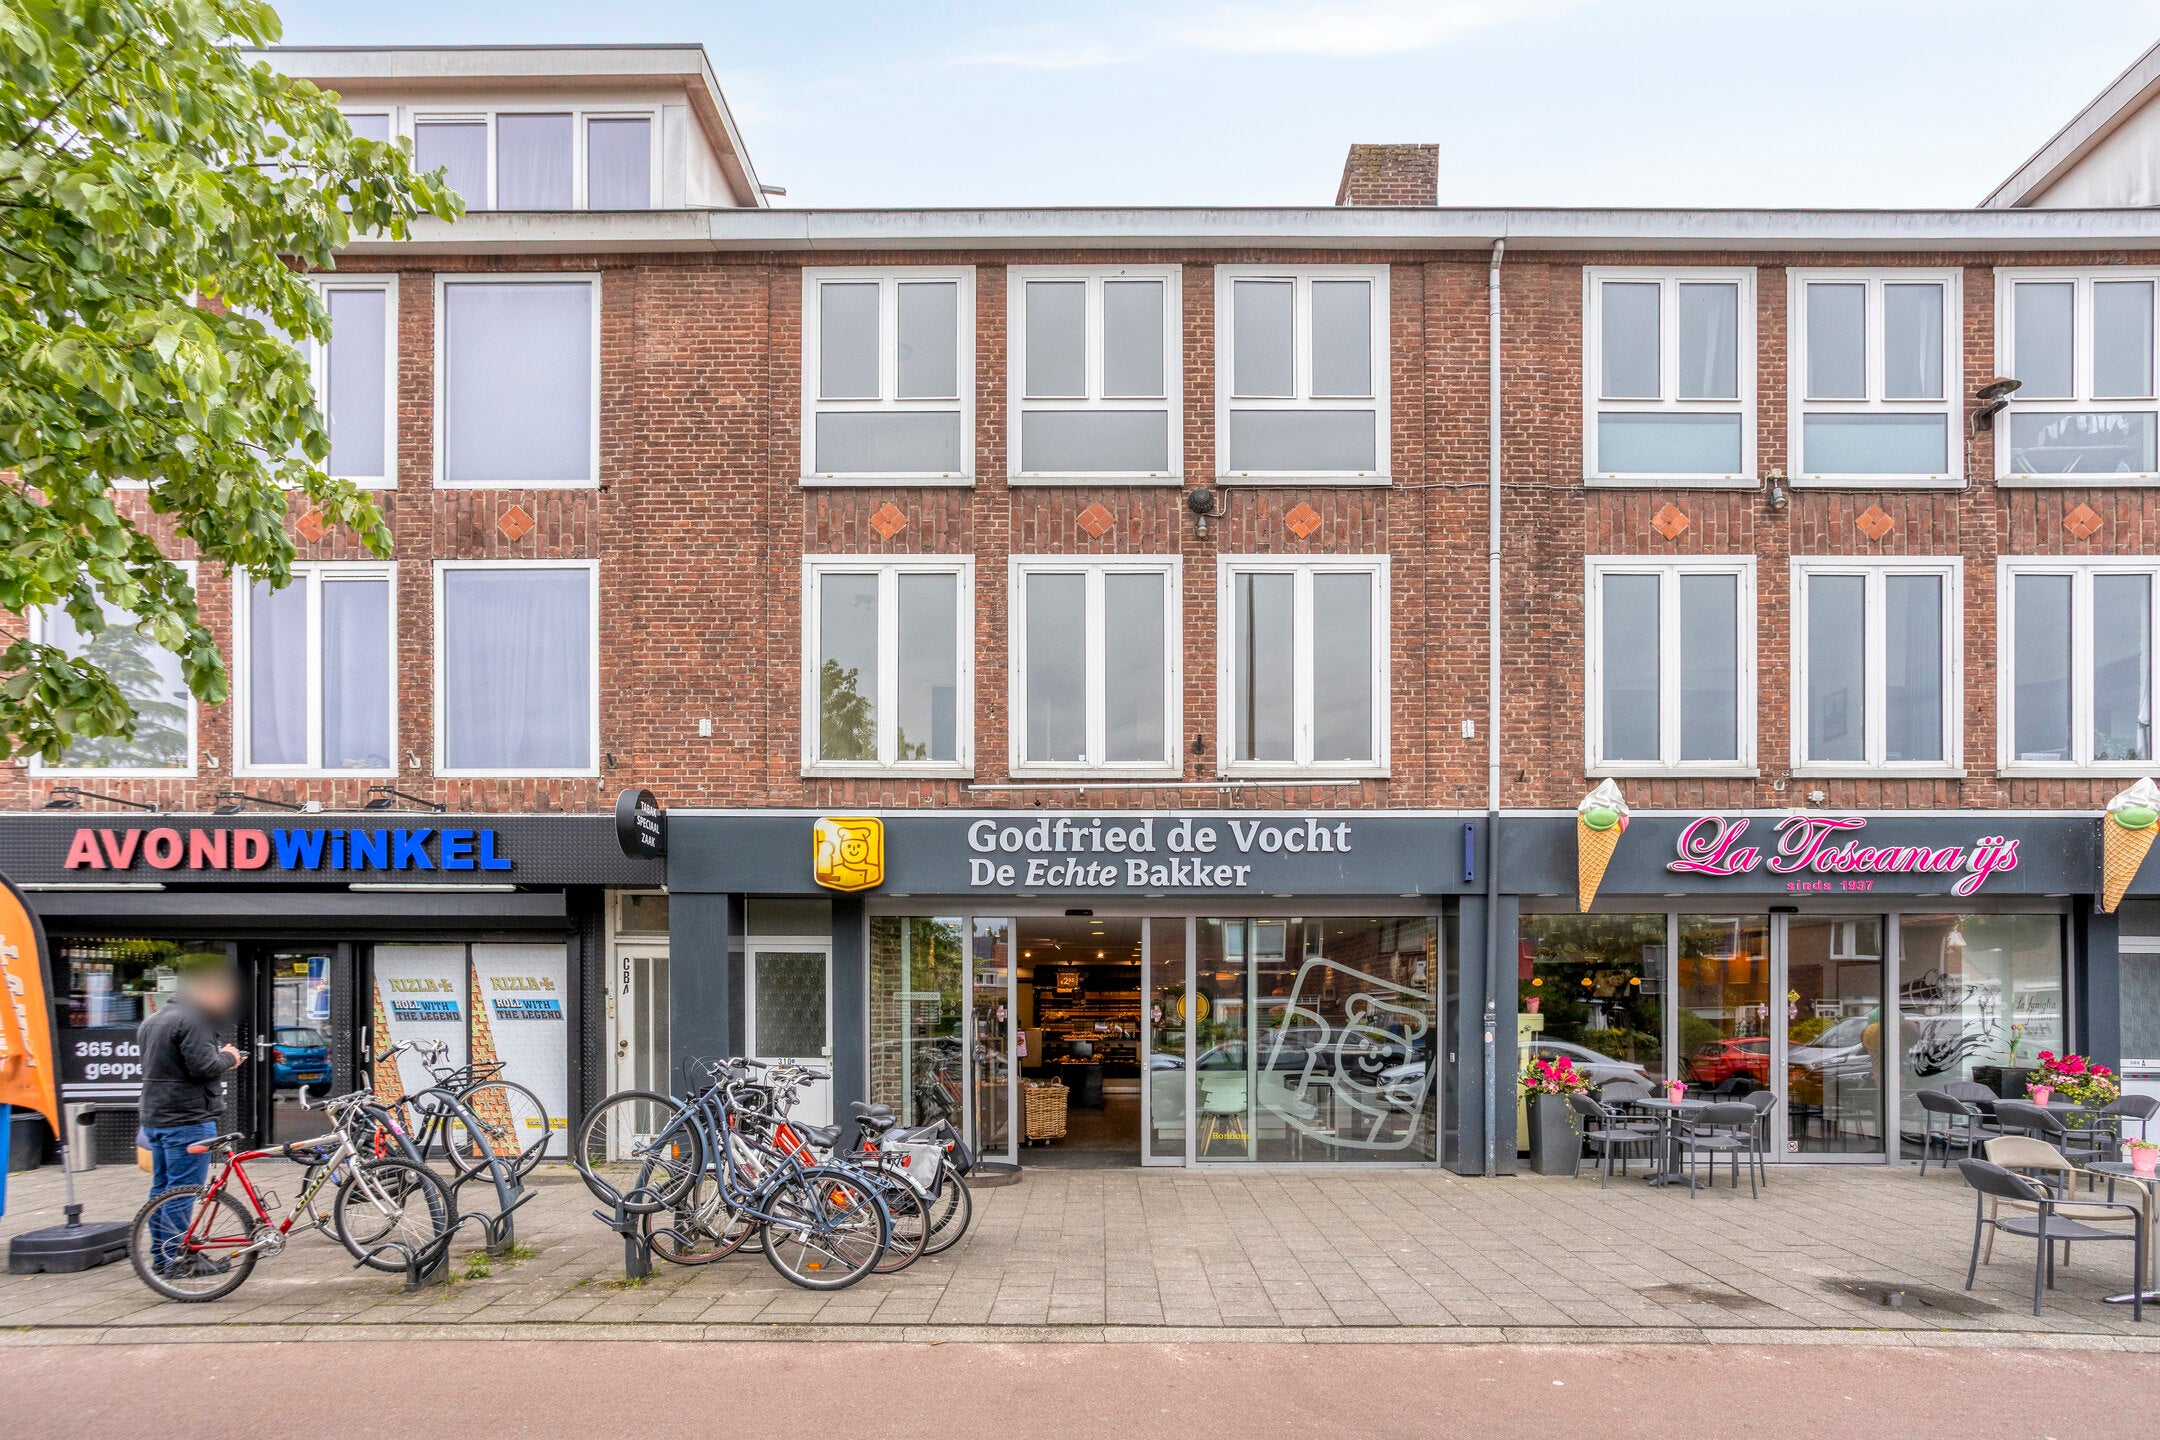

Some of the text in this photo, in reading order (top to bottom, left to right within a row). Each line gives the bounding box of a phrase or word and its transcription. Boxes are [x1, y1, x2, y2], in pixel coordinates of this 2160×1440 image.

[640, 801, 657, 817] TABAK
[636, 815, 660, 835] SPECIAAL
[641, 832, 656, 848] ZAAK
[967, 818, 1353, 853] Godfried de Vocht
[1667, 815, 1762, 877] La
[968, 857, 1252, 888] De Echte Bakker
[1786, 880, 1873, 892] sinds 1937
[394, 1000, 449, 1011] ROLL WITH
[495, 998, 551, 1010] ROLL WITH
[395, 1011, 461, 1021] THE LEGEND
[496, 1010, 562, 1020] THE LEGEND
[75, 1042, 112, 1057] 365
[85, 1063, 143, 1080] geope
[295, 1164, 332, 1212] GIANT
